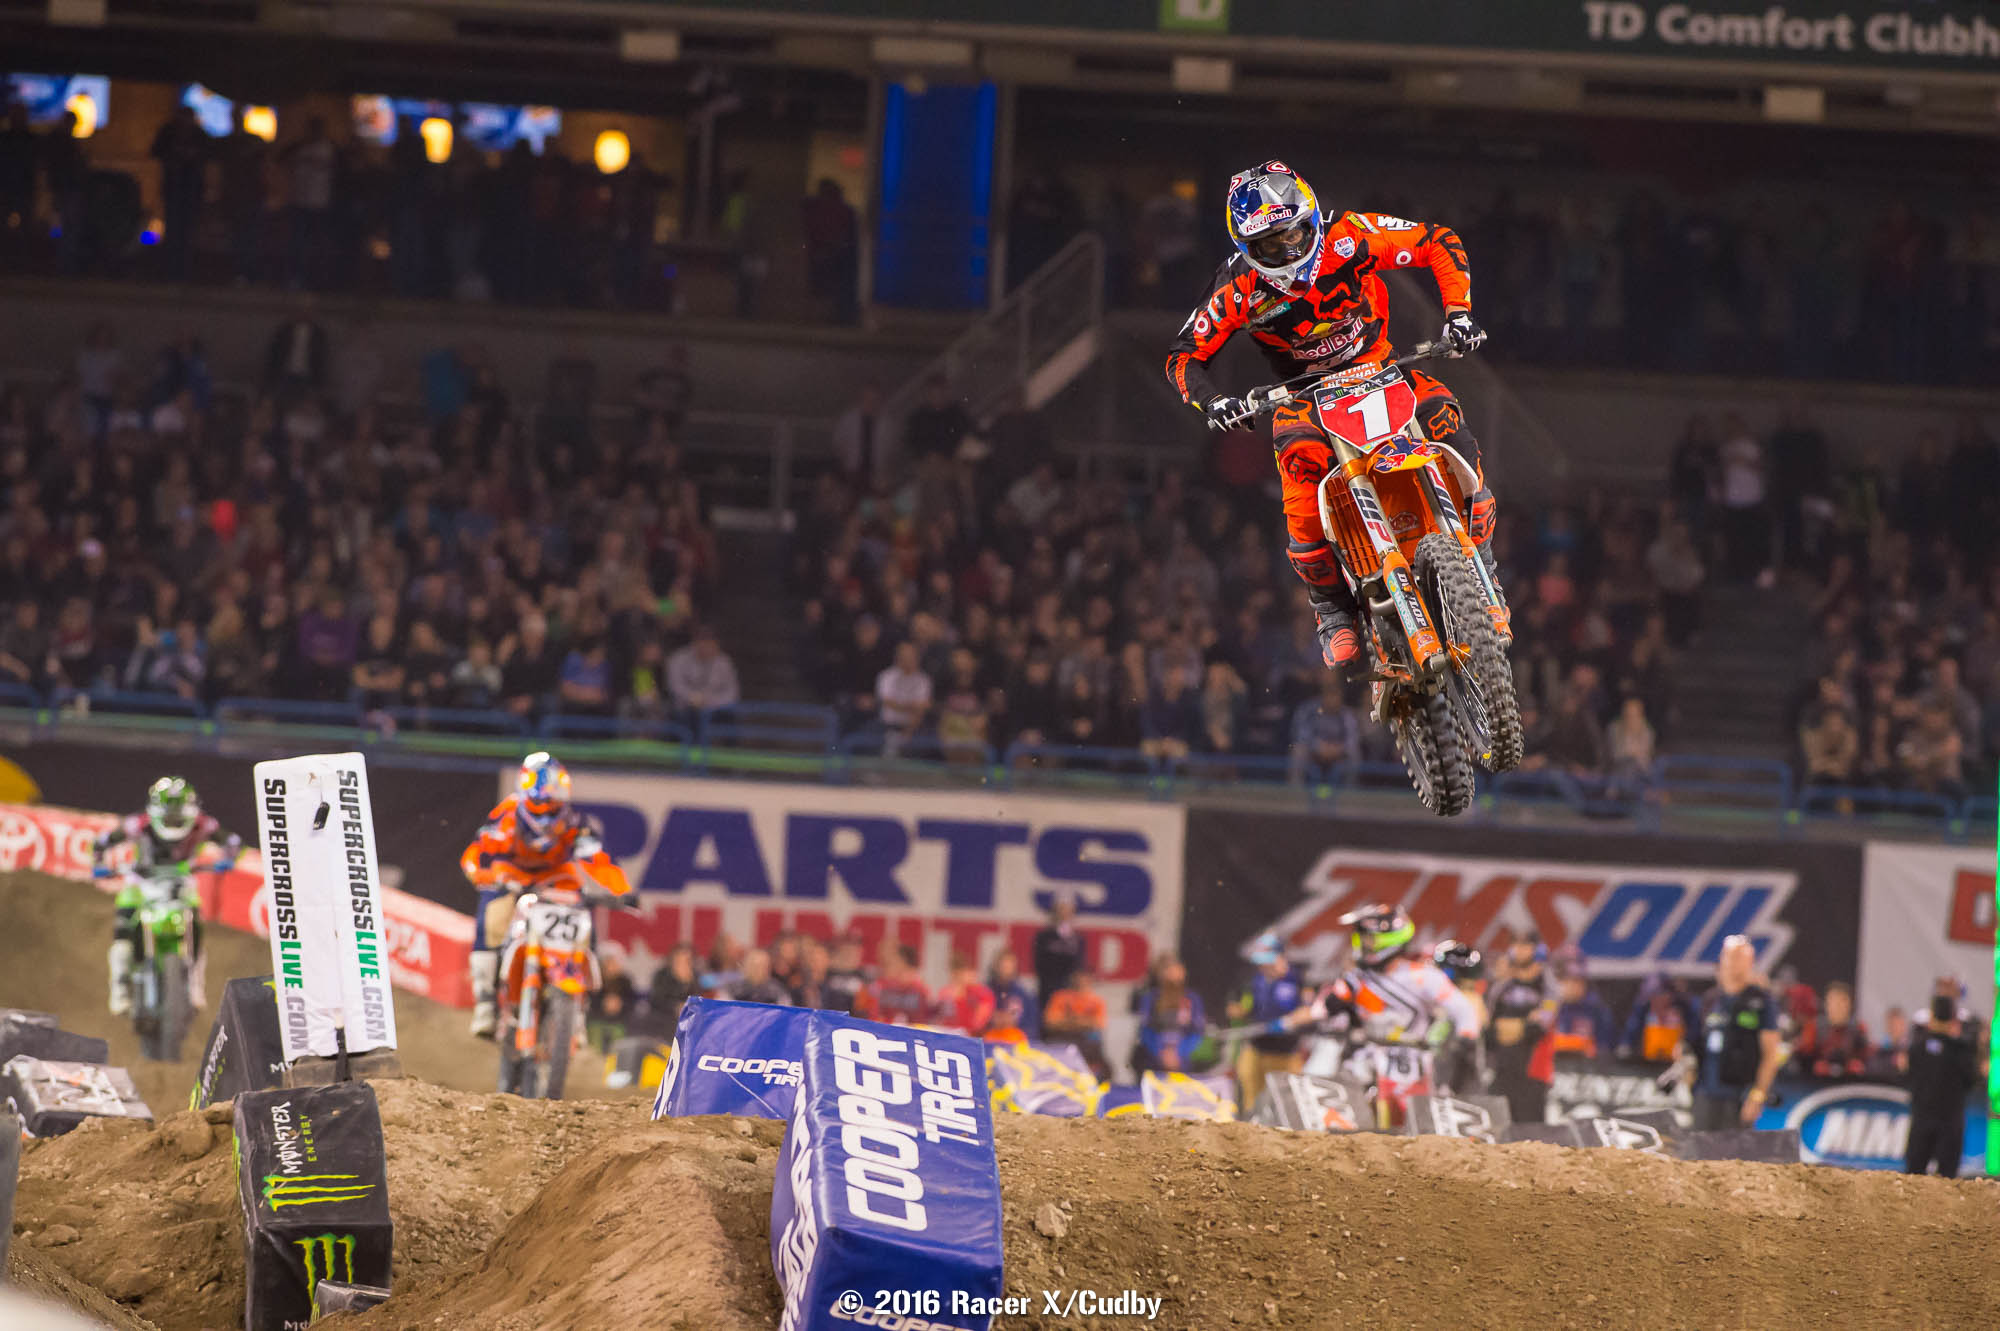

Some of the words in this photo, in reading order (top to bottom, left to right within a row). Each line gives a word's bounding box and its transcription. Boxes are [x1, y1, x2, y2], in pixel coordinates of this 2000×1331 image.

[1586, 3, 1646, 41] TD
[1656, 5, 1855, 50] Comfort
[1245, 213, 1268, 233] Red
[1268, 208, 1292, 223] Bull
[1328, 315, 1364, 351] Bull
[1347, 388, 1392, 441] 1
[545, 913, 579, 940] 25
[697, 1055, 804, 1074] COOPE
[762, 1073, 799, 1087] TIR
[914, 1043, 980, 1146] TIRES
[832, 1028, 928, 1232] COOPER
